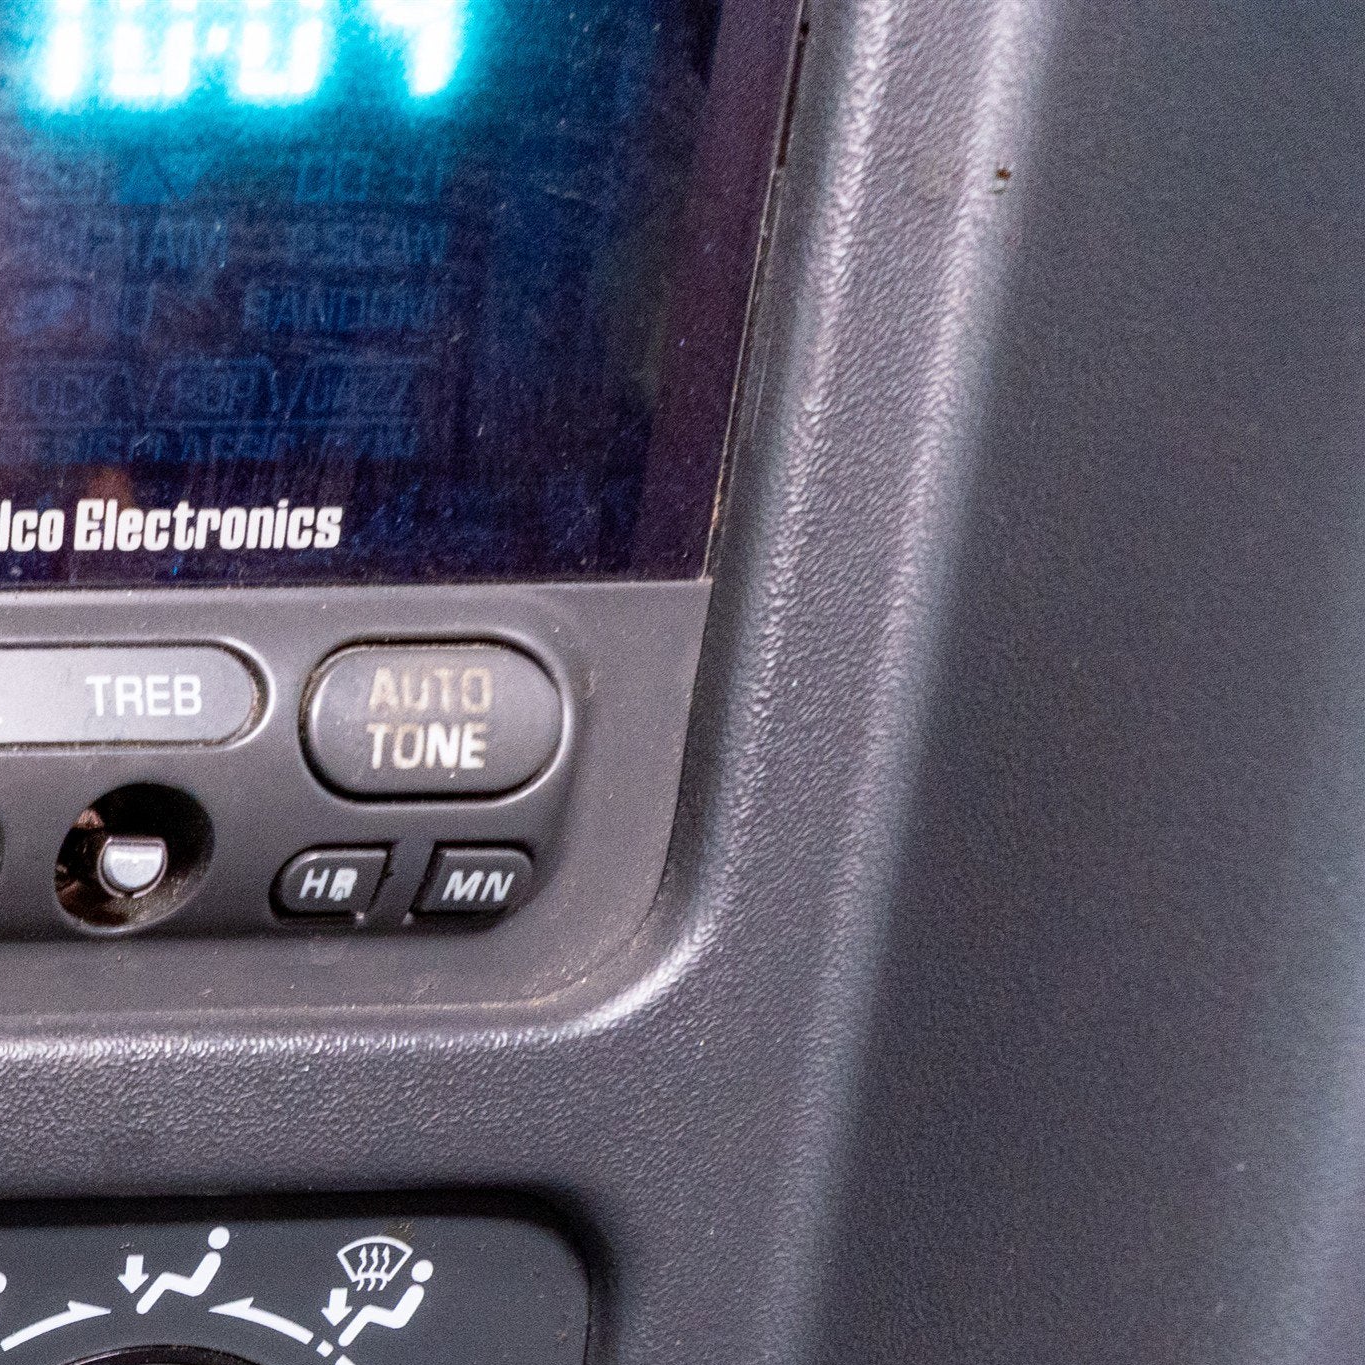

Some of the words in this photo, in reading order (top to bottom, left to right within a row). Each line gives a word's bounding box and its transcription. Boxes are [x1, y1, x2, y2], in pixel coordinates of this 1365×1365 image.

[73, 498, 343, 552] Electronics
[84, 675, 202, 717] TREB
[369, 668, 492, 712] AUTO
[367, 722, 486, 769] TONE
[442, 870, 514, 901] MN
